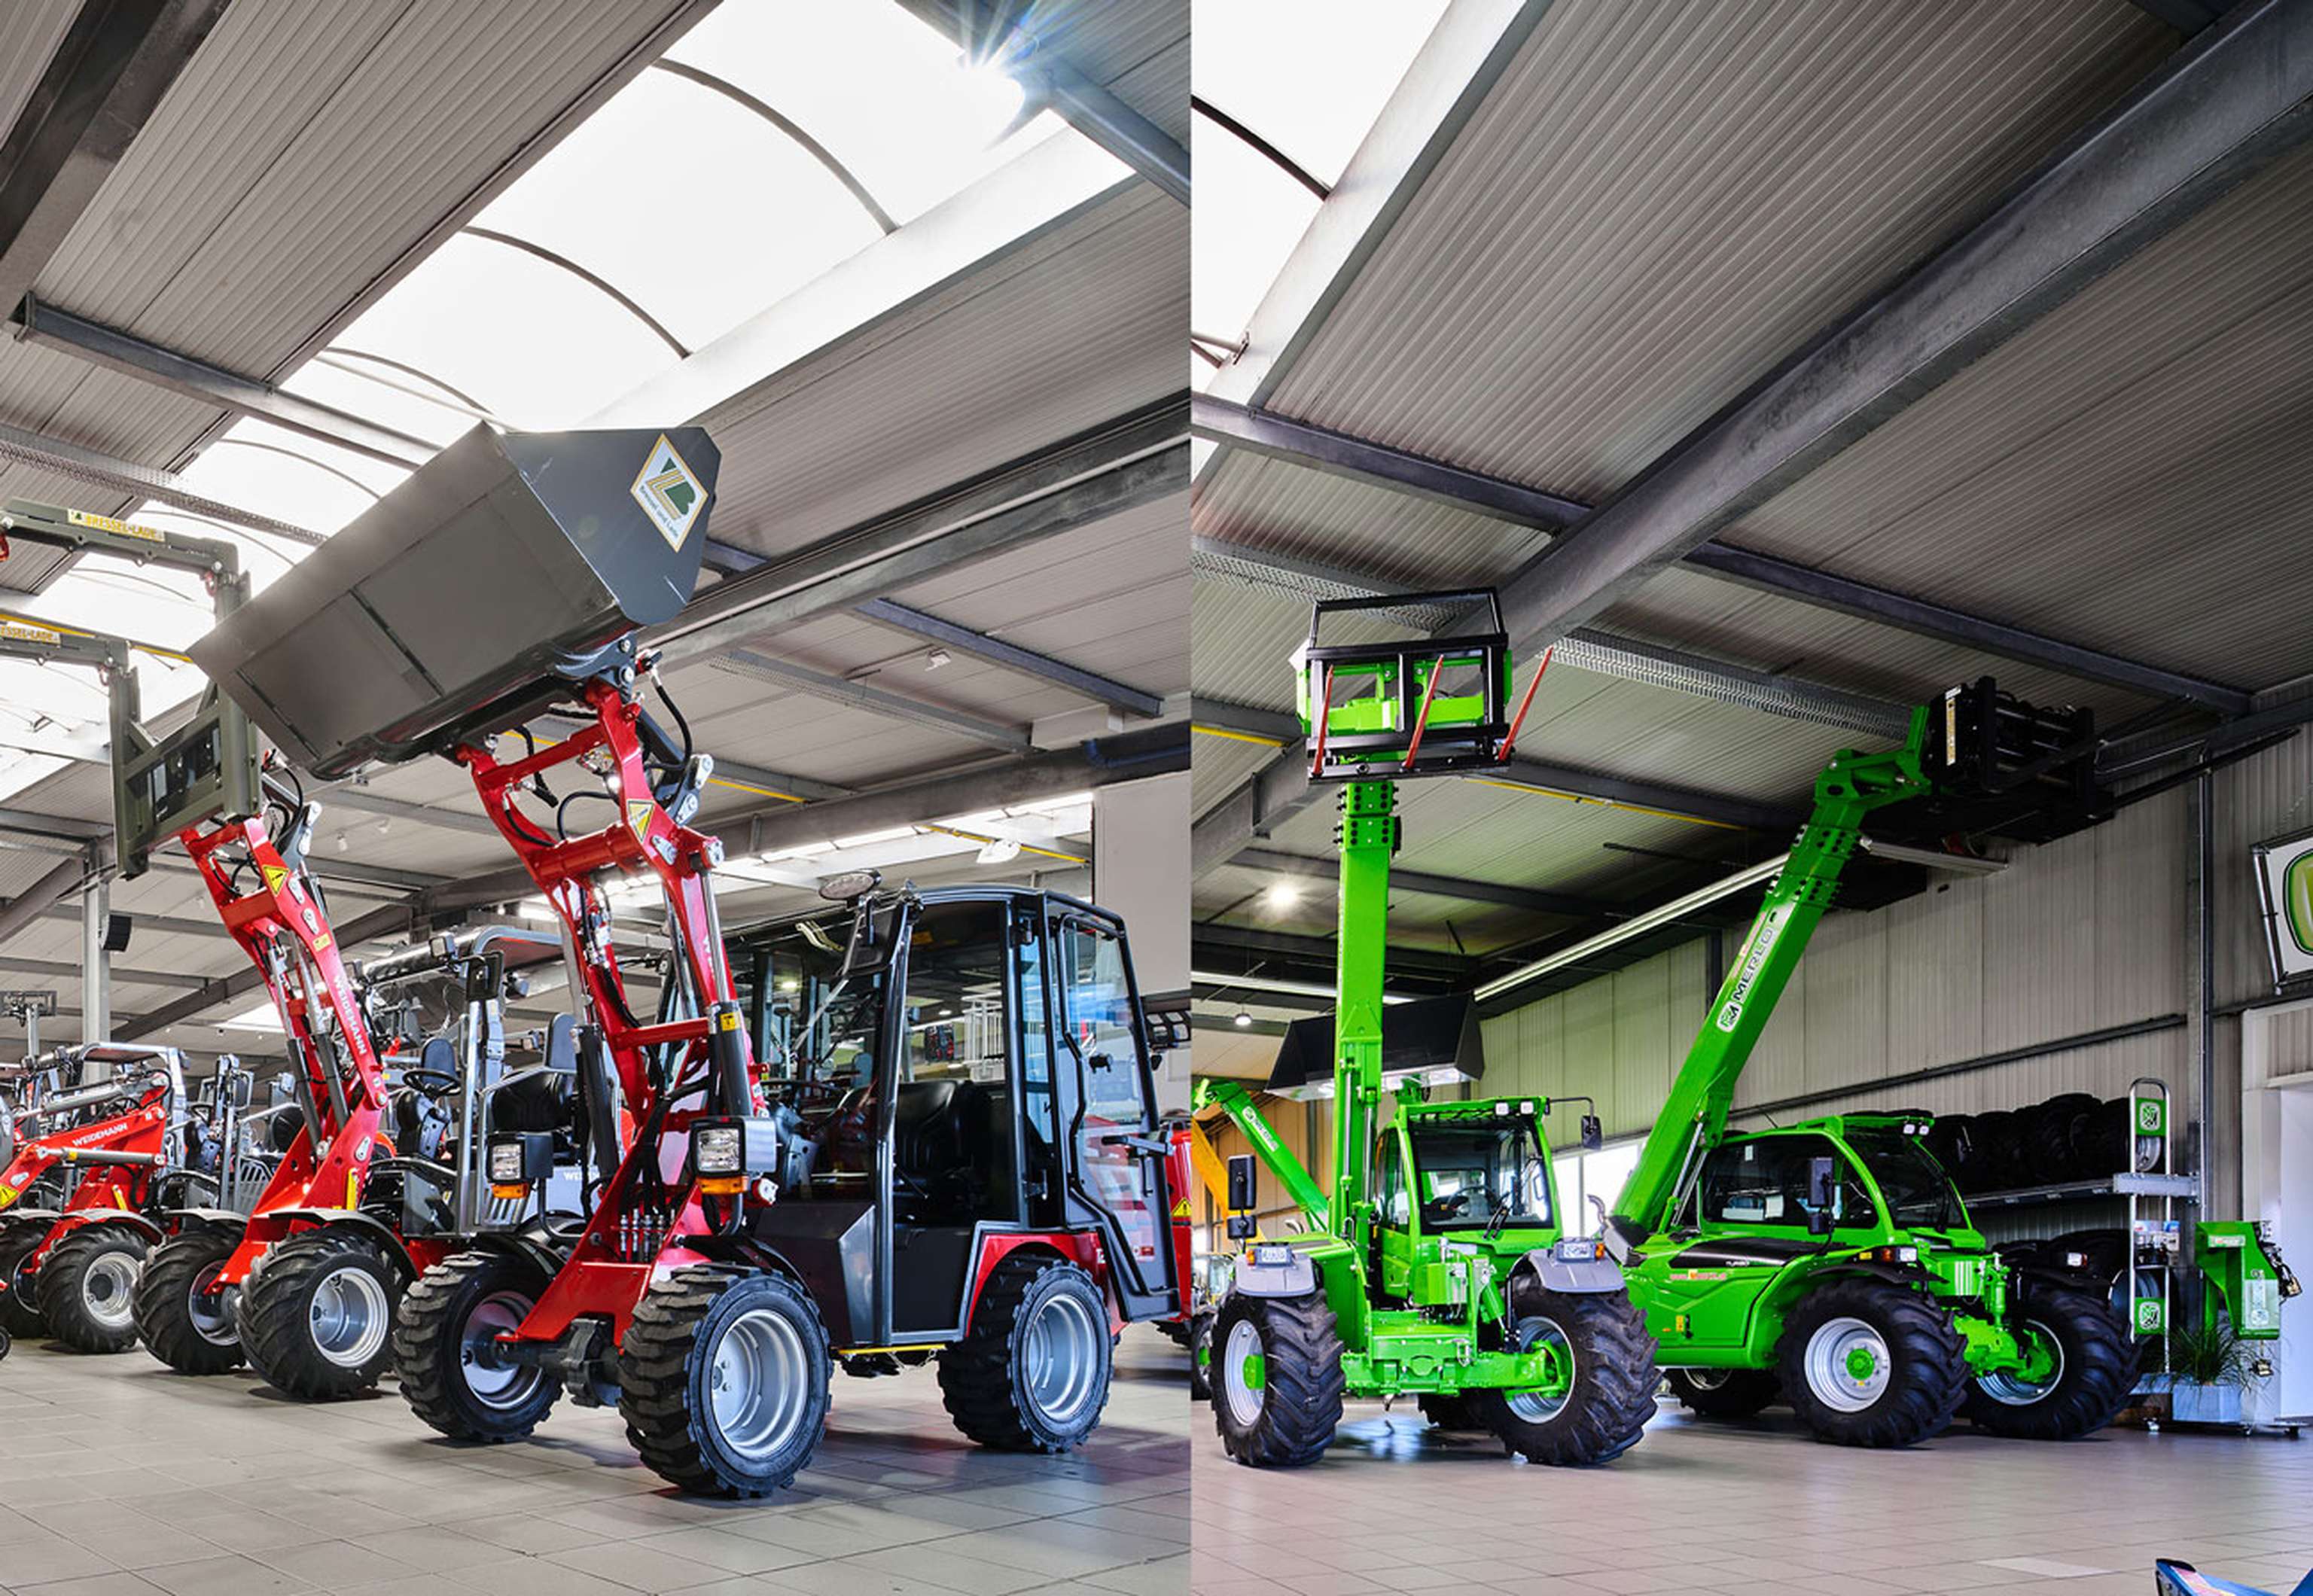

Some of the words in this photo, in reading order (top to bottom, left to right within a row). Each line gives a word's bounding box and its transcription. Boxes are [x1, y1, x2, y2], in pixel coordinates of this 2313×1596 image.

[1733, 929, 1773, 1001] MERLO
[334, 976, 367, 1054] WEIDEMANN
[72, 1122, 128, 1147] WEIDEMANN
